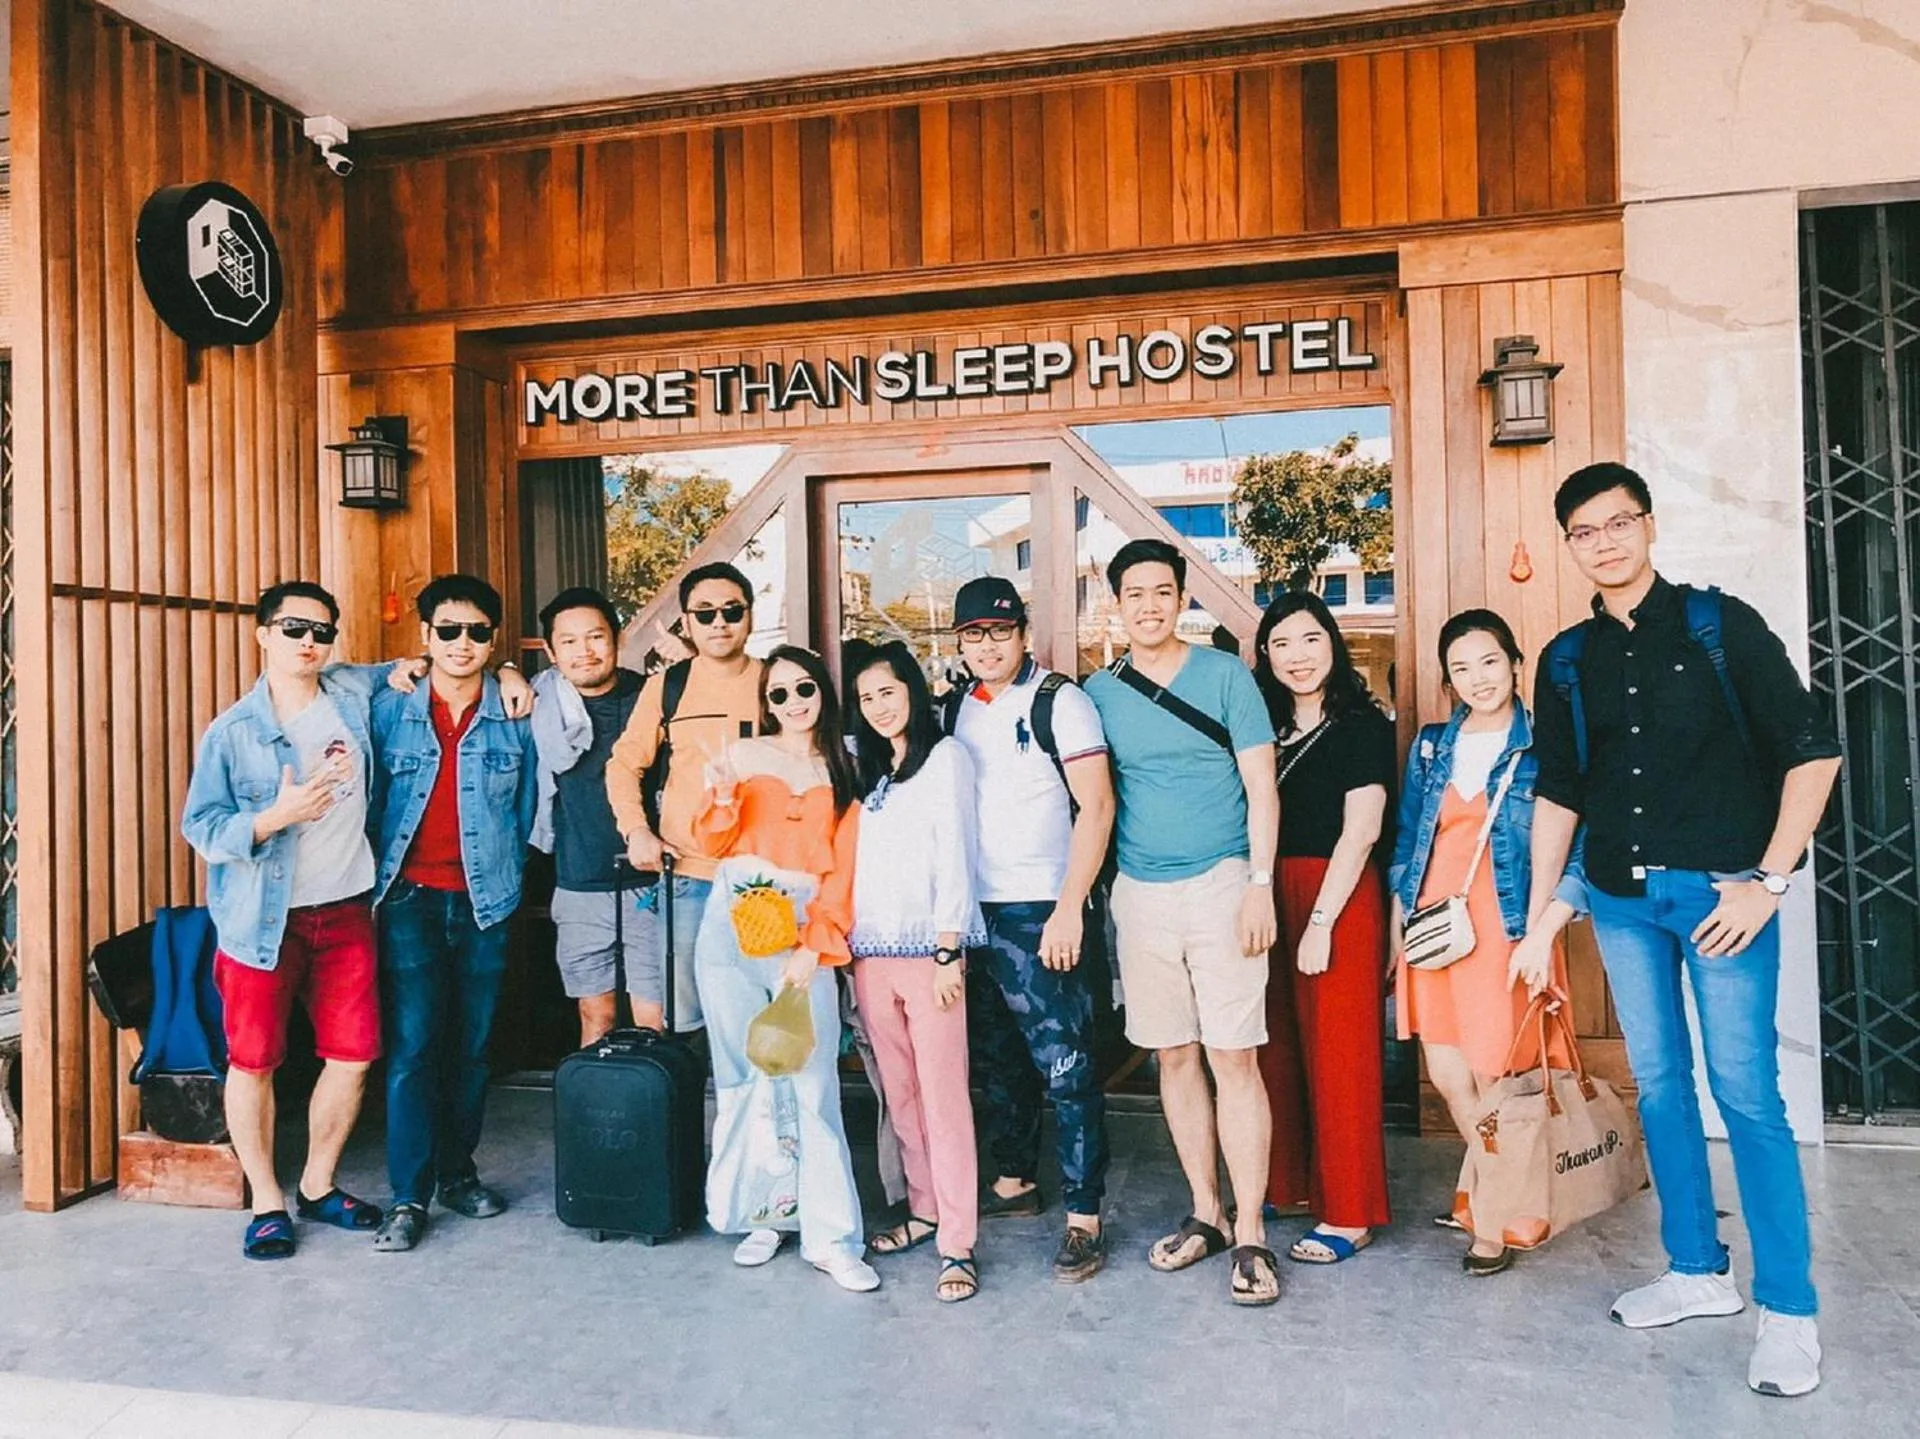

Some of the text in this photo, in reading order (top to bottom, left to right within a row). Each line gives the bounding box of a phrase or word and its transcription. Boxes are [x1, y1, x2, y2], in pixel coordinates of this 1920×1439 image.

[525, 317, 1375, 425] MORE THAN SLEEP HOSTEL
